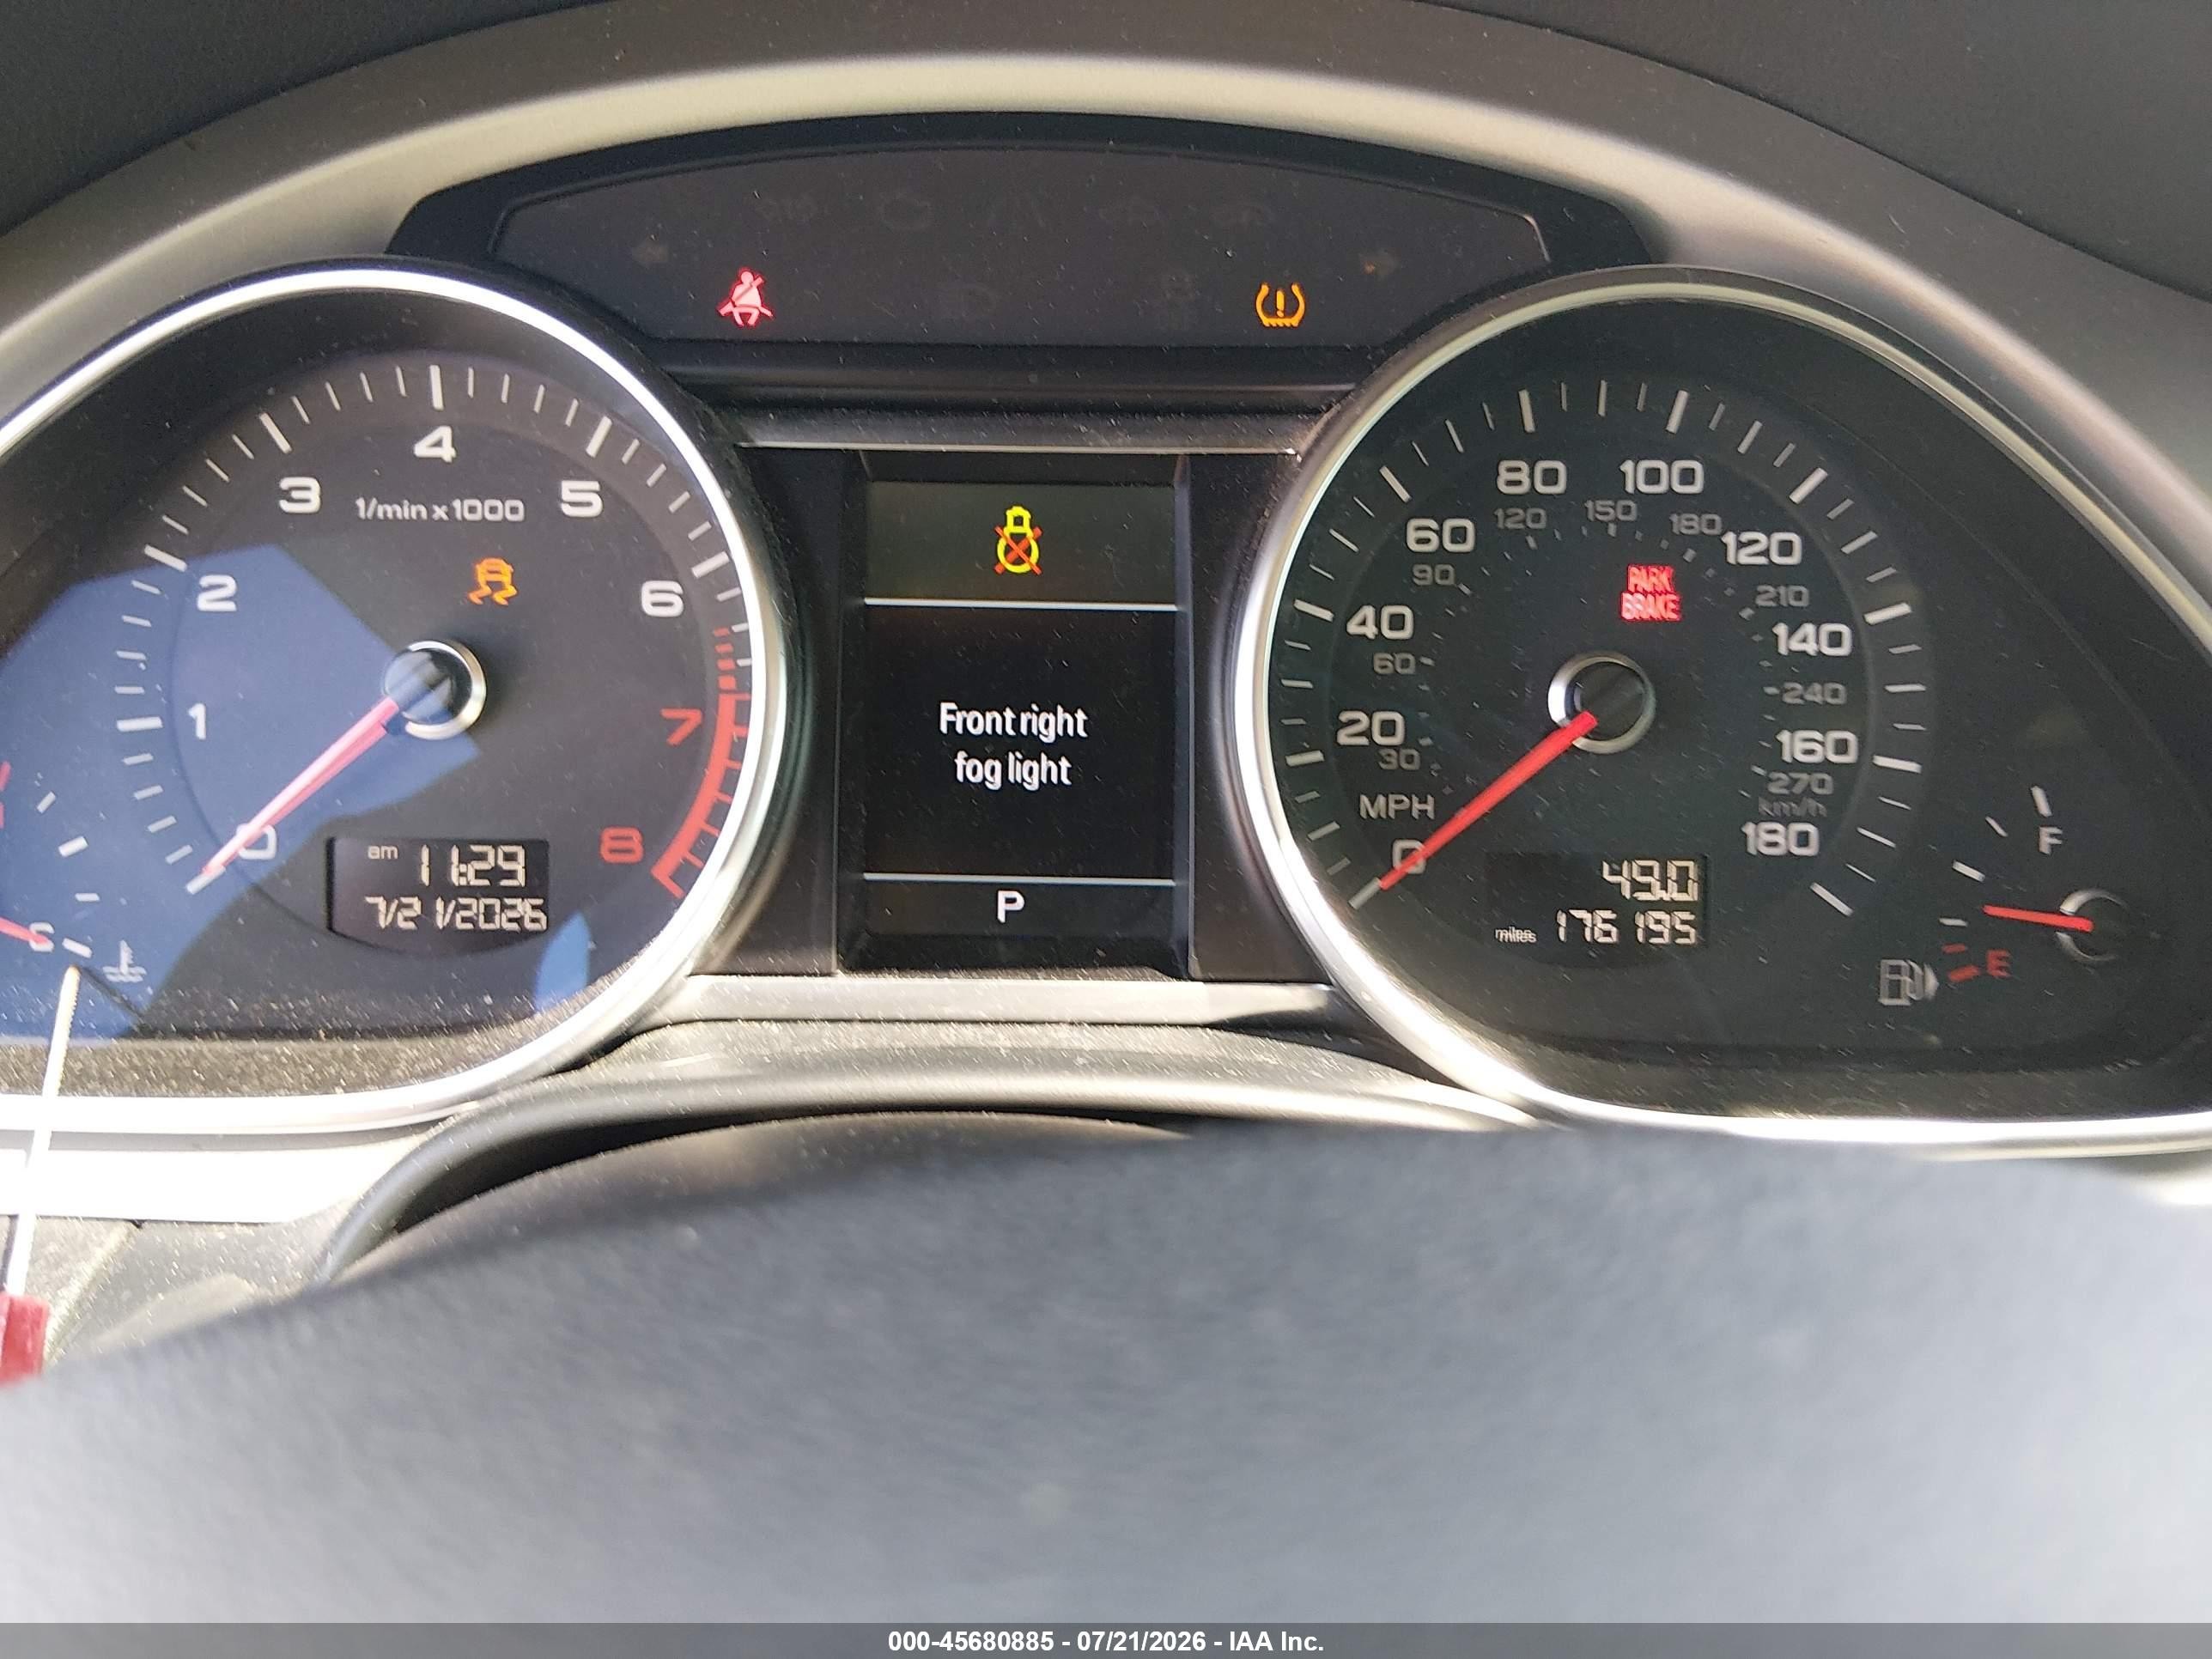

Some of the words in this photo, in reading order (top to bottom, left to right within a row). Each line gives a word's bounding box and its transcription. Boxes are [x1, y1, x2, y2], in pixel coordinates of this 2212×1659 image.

[415, 426, 455, 462] 4
[1498, 460, 1566, 494] 80
[1620, 460, 1705, 494] 100
[279, 477, 320, 513] 3
[356, 497, 428, 520] 1/min
[453, 498, 525, 521] 1000
[561, 481, 603, 516] 5
[1585, 500, 1638, 522] 150
[1496, 507, 1547, 530] 120
[1670, 514, 1722, 535] 180
[1407, 519, 1474, 552] 60
[1722, 532, 1802, 565] 120
[1413, 564, 1455, 586] 90
[1627, 565, 1674, 592] PARK
[198, 576, 236, 612] 2
[641, 580, 684, 617] 6
[1621, 592, 1680, 620] BRAKE
[1756, 586, 1808, 607] 210
[1346, 605, 1413, 640] 40
[1773, 623, 1852, 656] 140
[1374, 653, 1415, 674] 60
[1782, 683, 1845, 704] 240
[187, 704, 206, 739] 1
[661, 708, 701, 744] 7
[939, 702, 1016, 736] Front
[1020, 703, 1088, 744] right
[1337, 710, 1405, 745] 20
[1378, 749, 1420, 770] 30
[1777, 731, 1857, 763] 160
[954, 750, 1002, 791] fog
[1008, 750, 1072, 791] light
[1768, 772, 1833, 794] 270
[1359, 793, 1435, 819] MPH
[600, 826, 642, 862] 8
[1741, 821, 1819, 856] 180
[2039, 826, 2063, 854] F
[368, 845, 398, 860] am
[421, 844, 526, 887] 11:29
[1392, 839, 1426, 874] 0
[1601, 860, 1698, 901] 49.0
[997, 890, 1024, 924] P
[1495, 926, 1537, 943] miles
[1987, 949, 2011, 978] E
